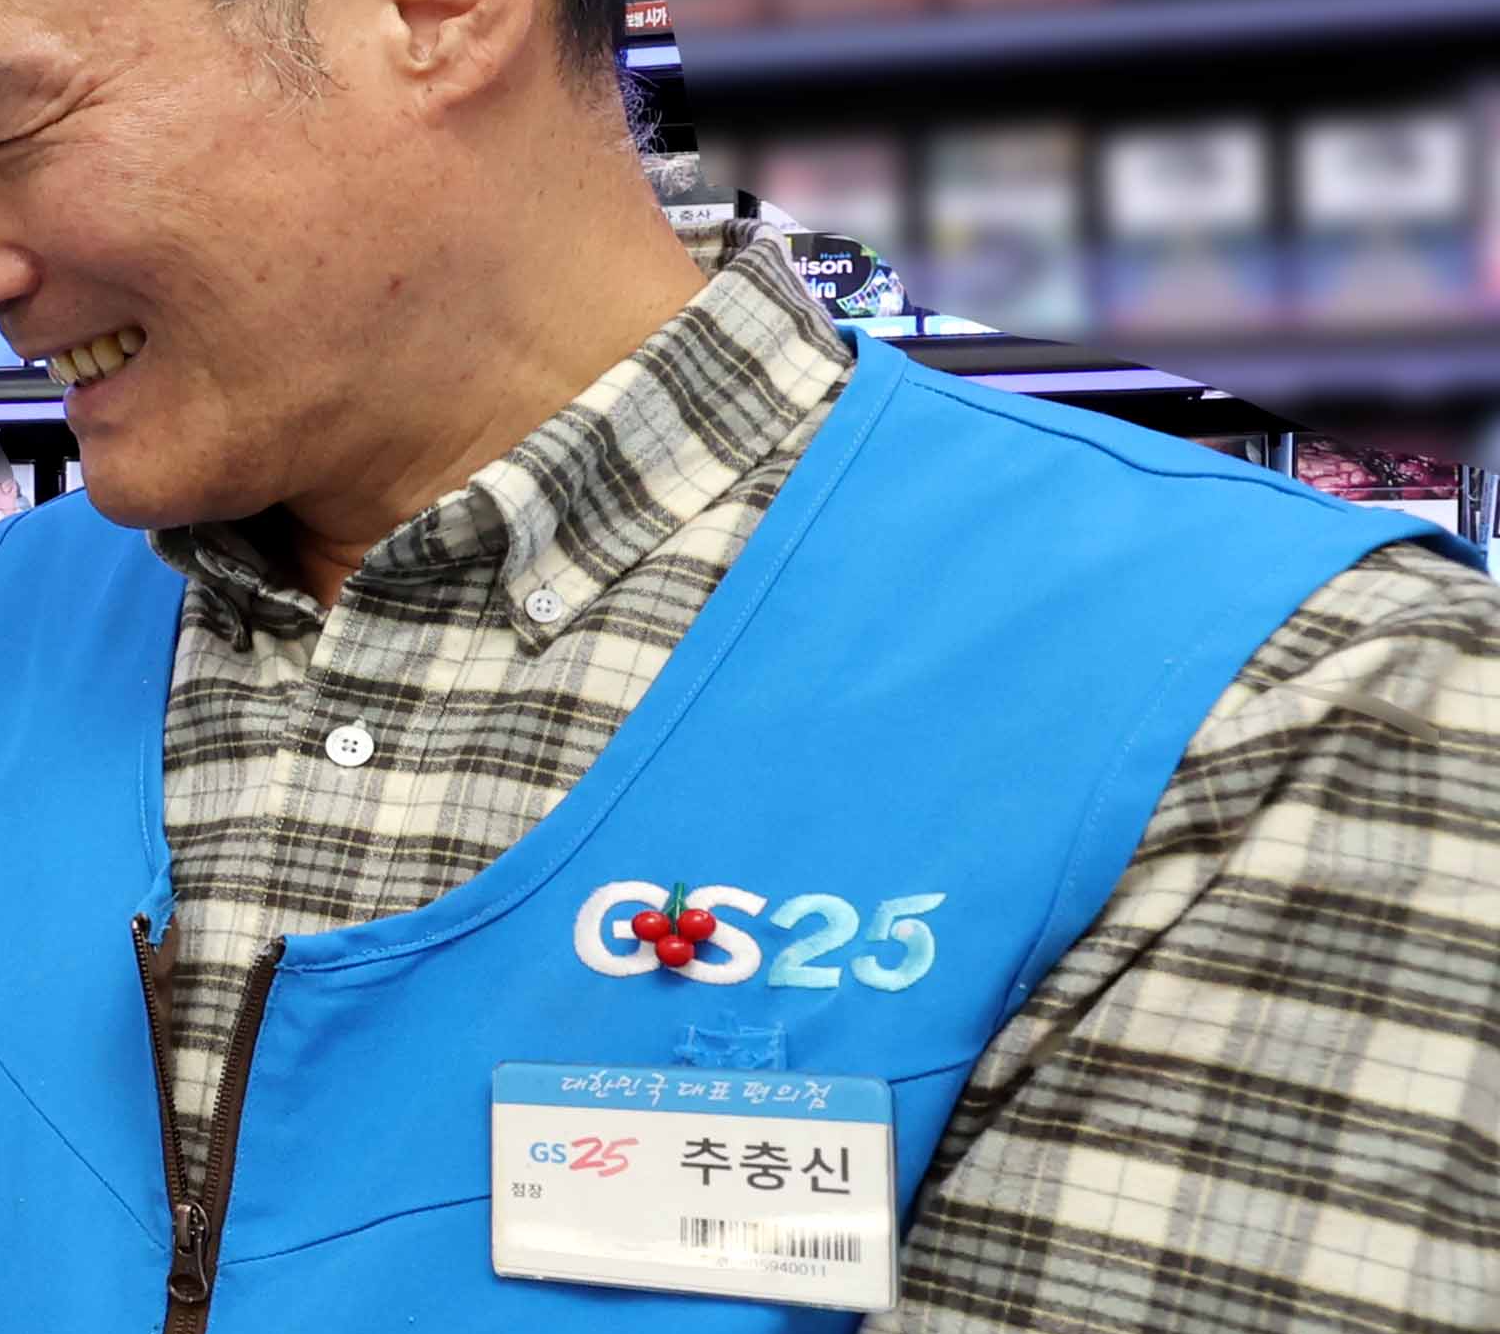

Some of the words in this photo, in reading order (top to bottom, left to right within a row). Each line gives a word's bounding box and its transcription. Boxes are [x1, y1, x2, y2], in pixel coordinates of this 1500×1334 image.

[574, 880, 946, 992] GS25
[560, 1070, 668, 1107] 대한민국
[677, 1080, 732, 1103] 대표
[743, 1080, 833, 1110] 편의점
[528, 1135, 640, 1178] GS25
[680, 1137, 851, 1195] 추충신
[510, 1181, 544, 1200] 점장
